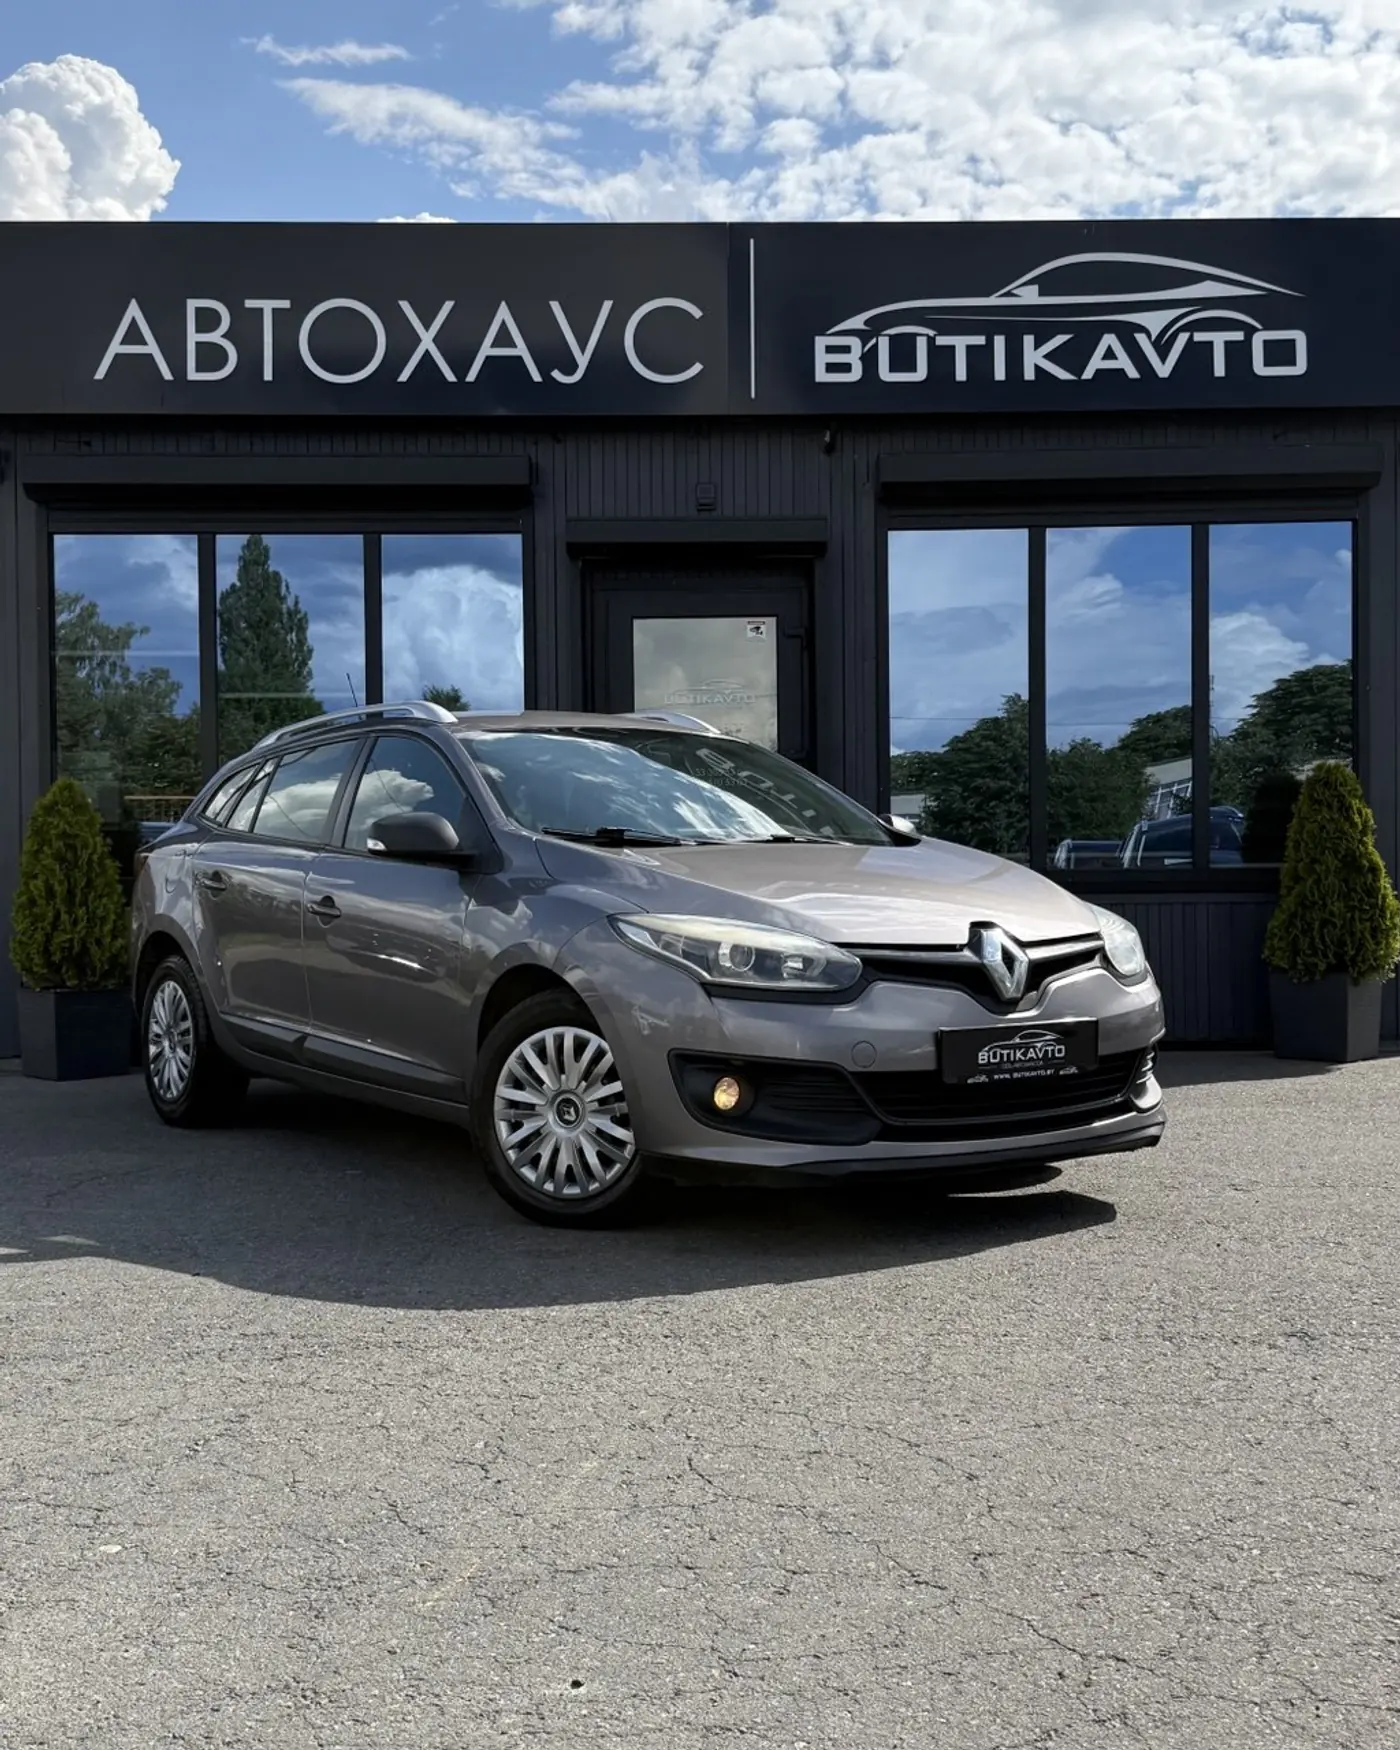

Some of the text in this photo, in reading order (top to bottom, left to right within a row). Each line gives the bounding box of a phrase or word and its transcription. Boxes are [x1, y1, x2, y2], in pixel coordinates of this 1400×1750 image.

[93, 297, 704, 384] АВТОХАУС
[814, 328, 1308, 383] BUTIKAVTO
[978, 1045, 1065, 1064] BUTIKAVTO
